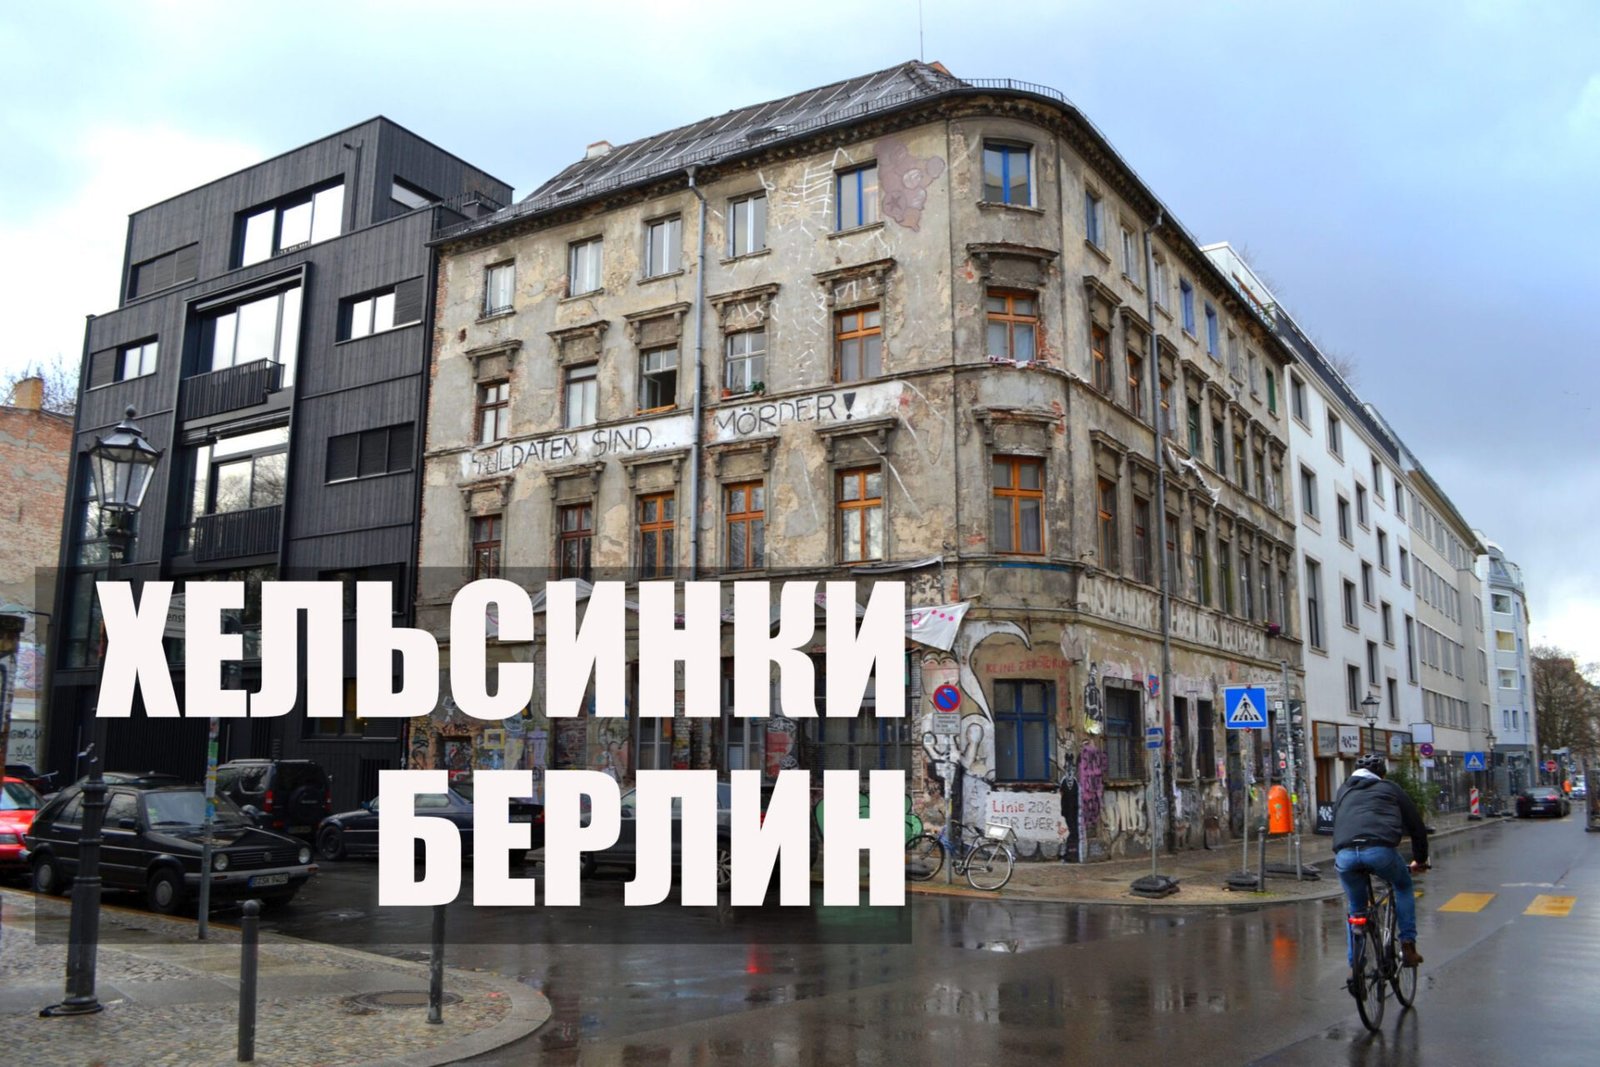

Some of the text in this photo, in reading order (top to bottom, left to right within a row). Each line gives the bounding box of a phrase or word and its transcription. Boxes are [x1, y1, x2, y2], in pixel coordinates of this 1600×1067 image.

[992, 800, 1052, 814] Linie 206
[1024, 816, 1054, 831] EVER
